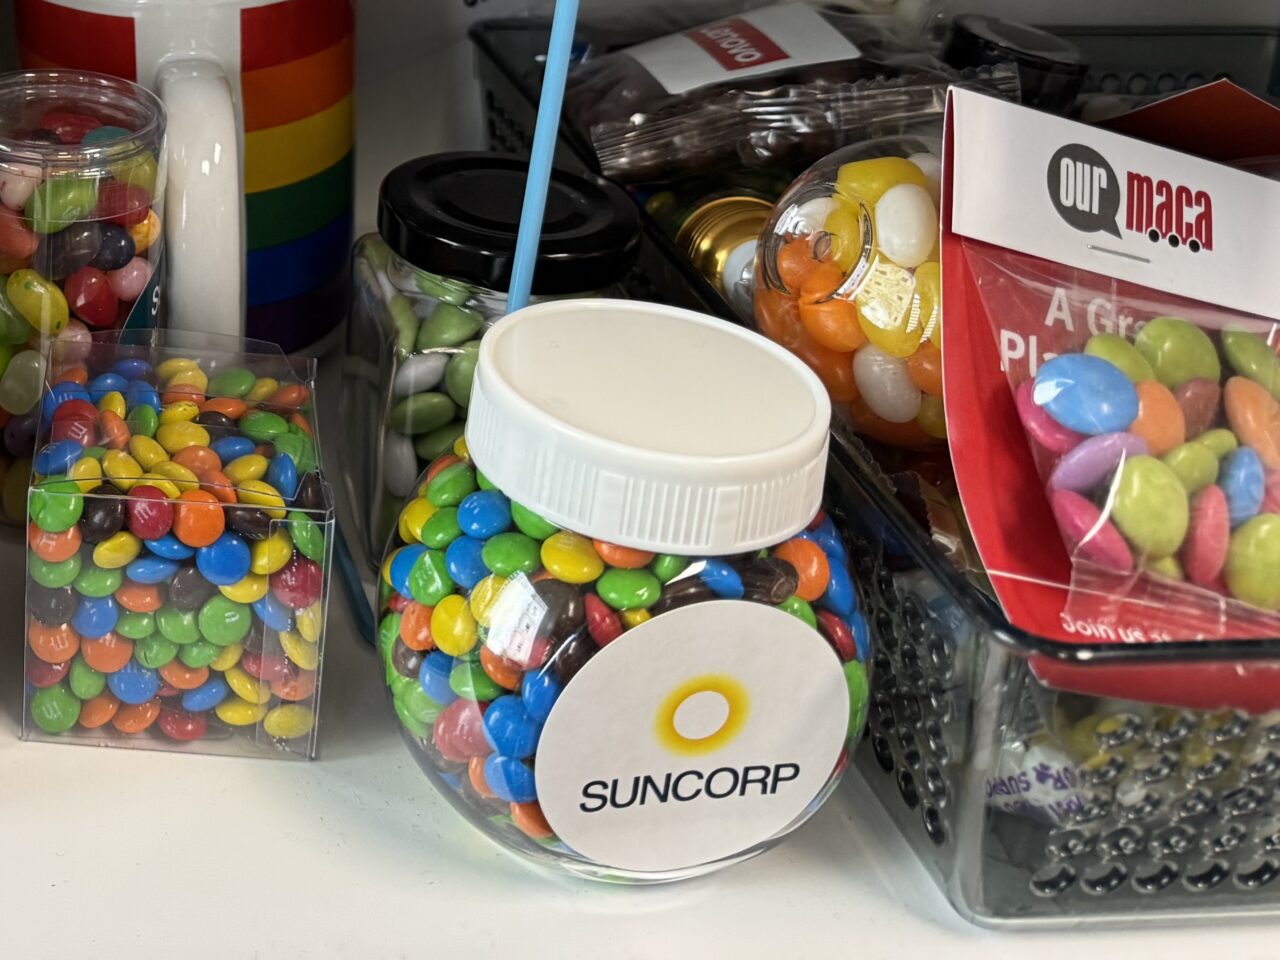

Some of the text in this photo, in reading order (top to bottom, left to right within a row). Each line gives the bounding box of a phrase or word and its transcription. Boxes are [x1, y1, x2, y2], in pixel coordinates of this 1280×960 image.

[1059, 157, 1108, 215] our
[1044, 286, 1074, 332] A
[579, 762, 800, 813] SUNCORP
